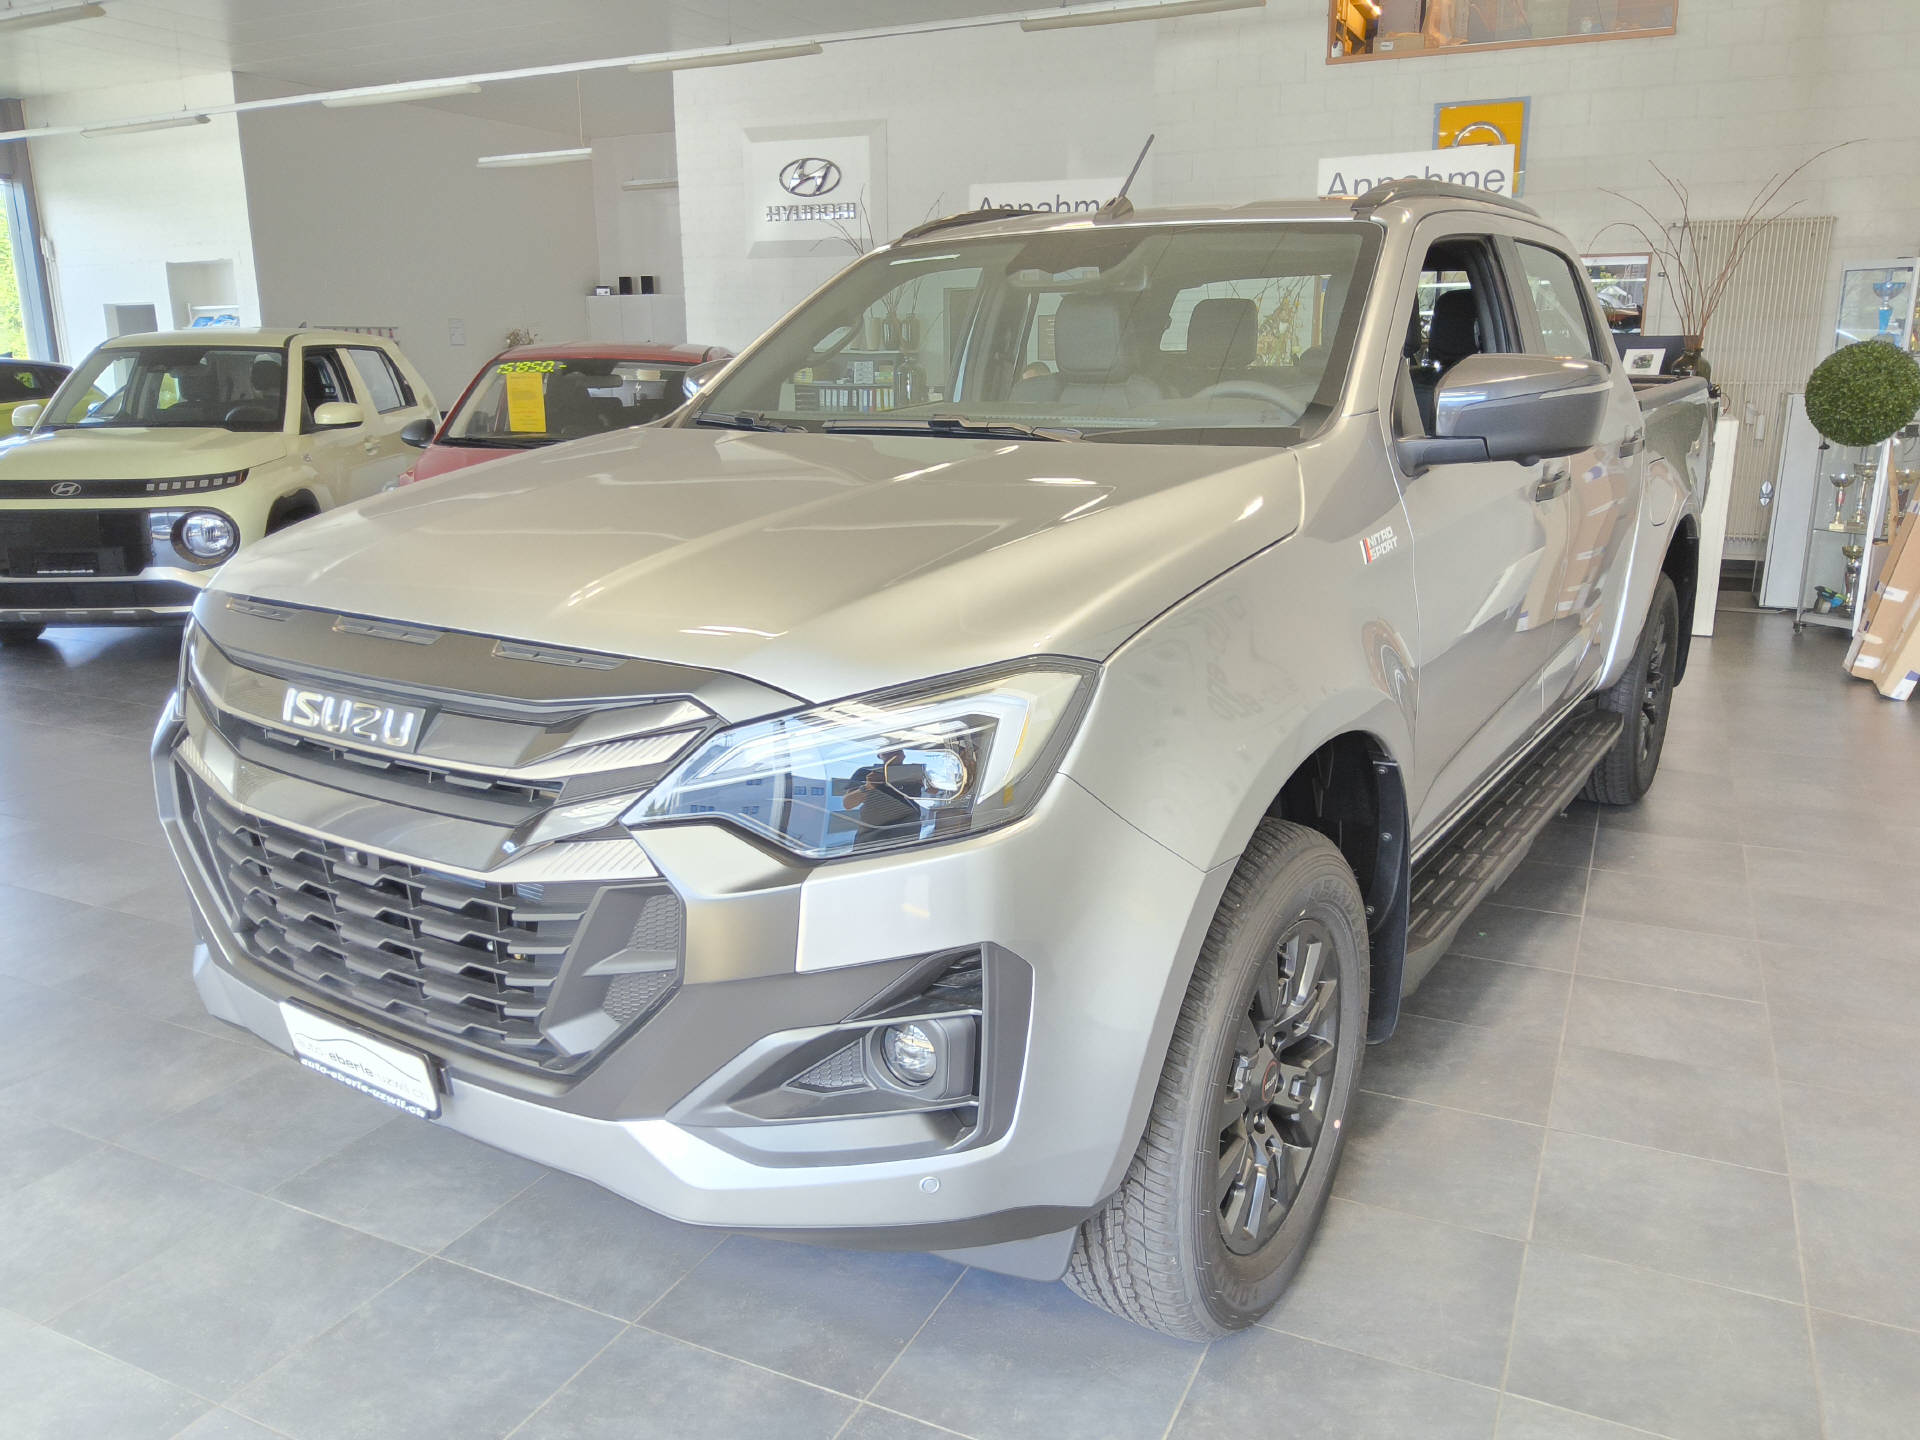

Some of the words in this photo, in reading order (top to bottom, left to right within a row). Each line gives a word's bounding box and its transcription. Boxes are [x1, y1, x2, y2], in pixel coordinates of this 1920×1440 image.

[1327, 165, 1505, 195] Annhme
[766, 202, 856, 222] HYUNDAI
[980, 193, 1101, 213] Annahm
[283, 688, 415, 747] ISUZU
[300, 1057, 427, 1119] auto-eberle-uzwil.ch
